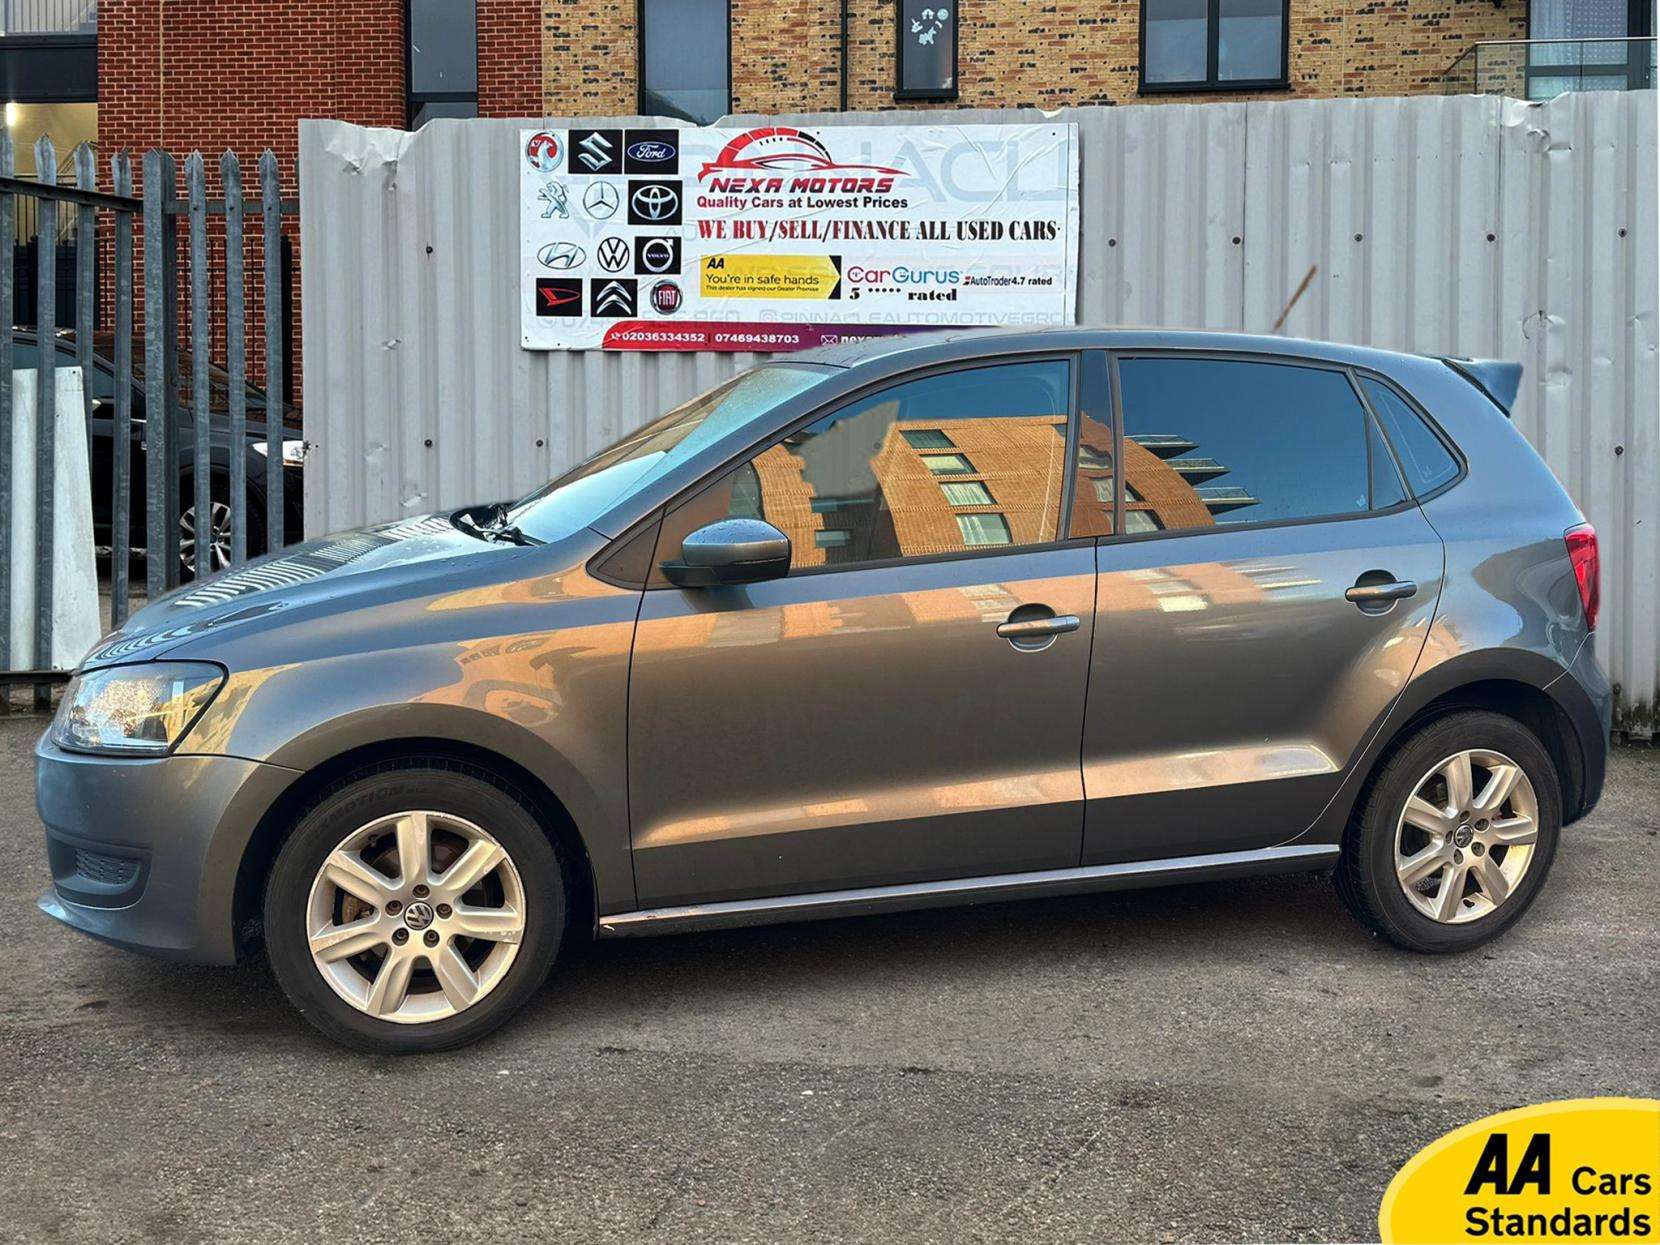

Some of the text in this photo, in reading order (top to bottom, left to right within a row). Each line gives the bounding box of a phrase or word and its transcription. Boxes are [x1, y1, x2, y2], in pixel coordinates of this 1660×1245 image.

[636, 144, 665, 159] Ford
[709, 178, 895, 193] NEXA MOTORS
[697, 196, 909, 210] Quality Cars at Lowest Prices
[697, 220, 726, 239] WE
[917, 220, 951, 240] ALL
[956, 220, 1003, 240] USED
[1008, 220, 1057, 240] CARS
[706, 257, 725, 269] AA
[705, 274, 820, 285] You're in safe hands
[847, 266, 960, 284] CarGurus
[1027, 277, 1053, 286] rated
[657, 289, 676, 306] FIAT
[849, 287, 958, 301] 5 rated
[621, 332, 705, 343] 02036334352
[714, 333, 799, 344] 07469438703
